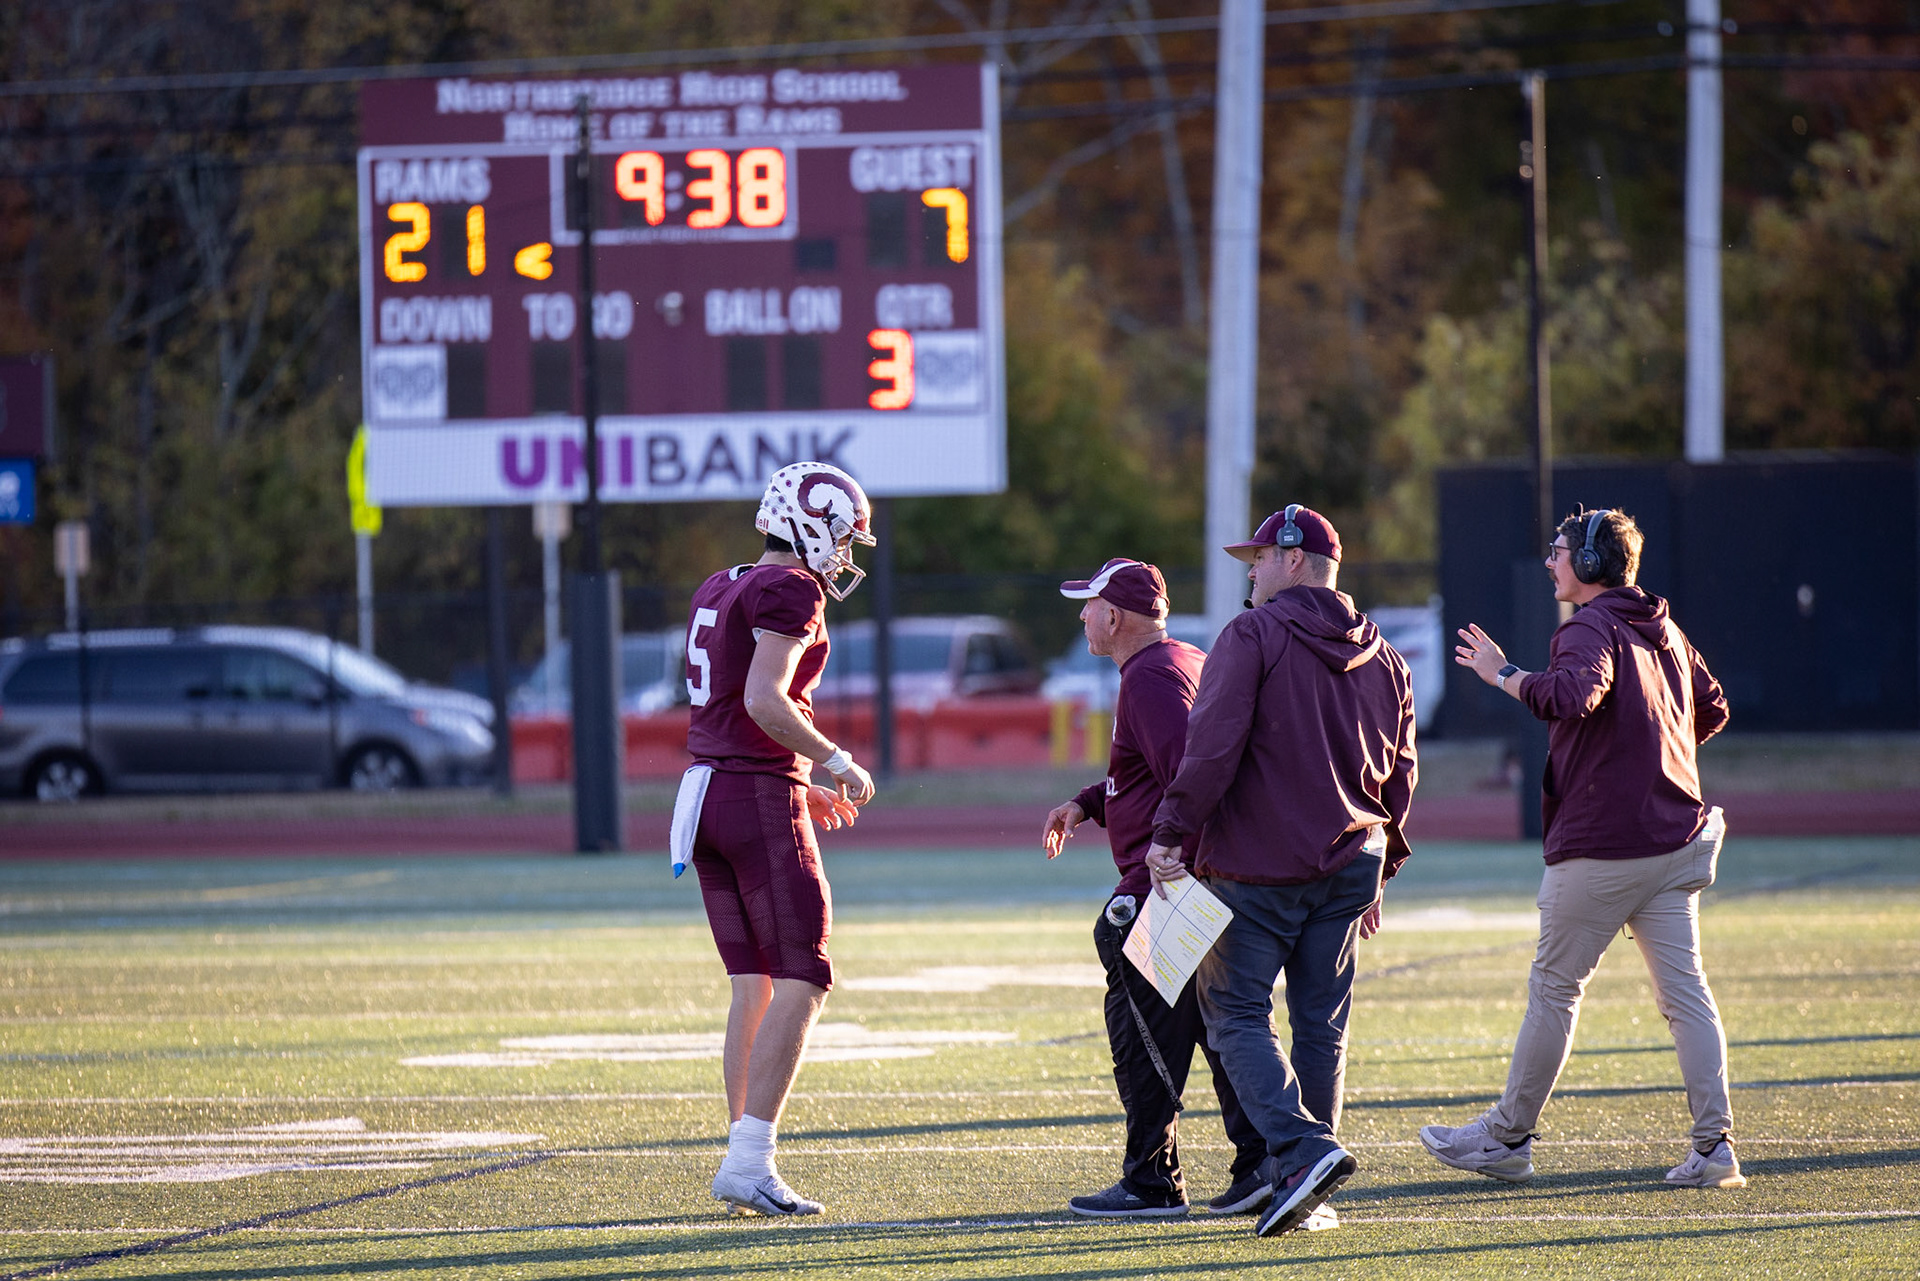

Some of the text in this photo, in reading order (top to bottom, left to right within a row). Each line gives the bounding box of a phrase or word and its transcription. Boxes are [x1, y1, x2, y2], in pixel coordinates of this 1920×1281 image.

[374, 158, 492, 204] RAMS
[615, 146, 788, 229] 9:38
[850, 145, 972, 192] GUEST
[384, 201, 487, 283] 21
[920, 187, 970, 263] 7
[379, 294, 493, 343] DOWN
[521, 291, 577, 341] TO
[704, 285, 842, 336] BALL ON
[867, 328, 915, 411] 3
[501, 426, 860, 488] UNIBANK
[686, 607, 718, 707] 5
